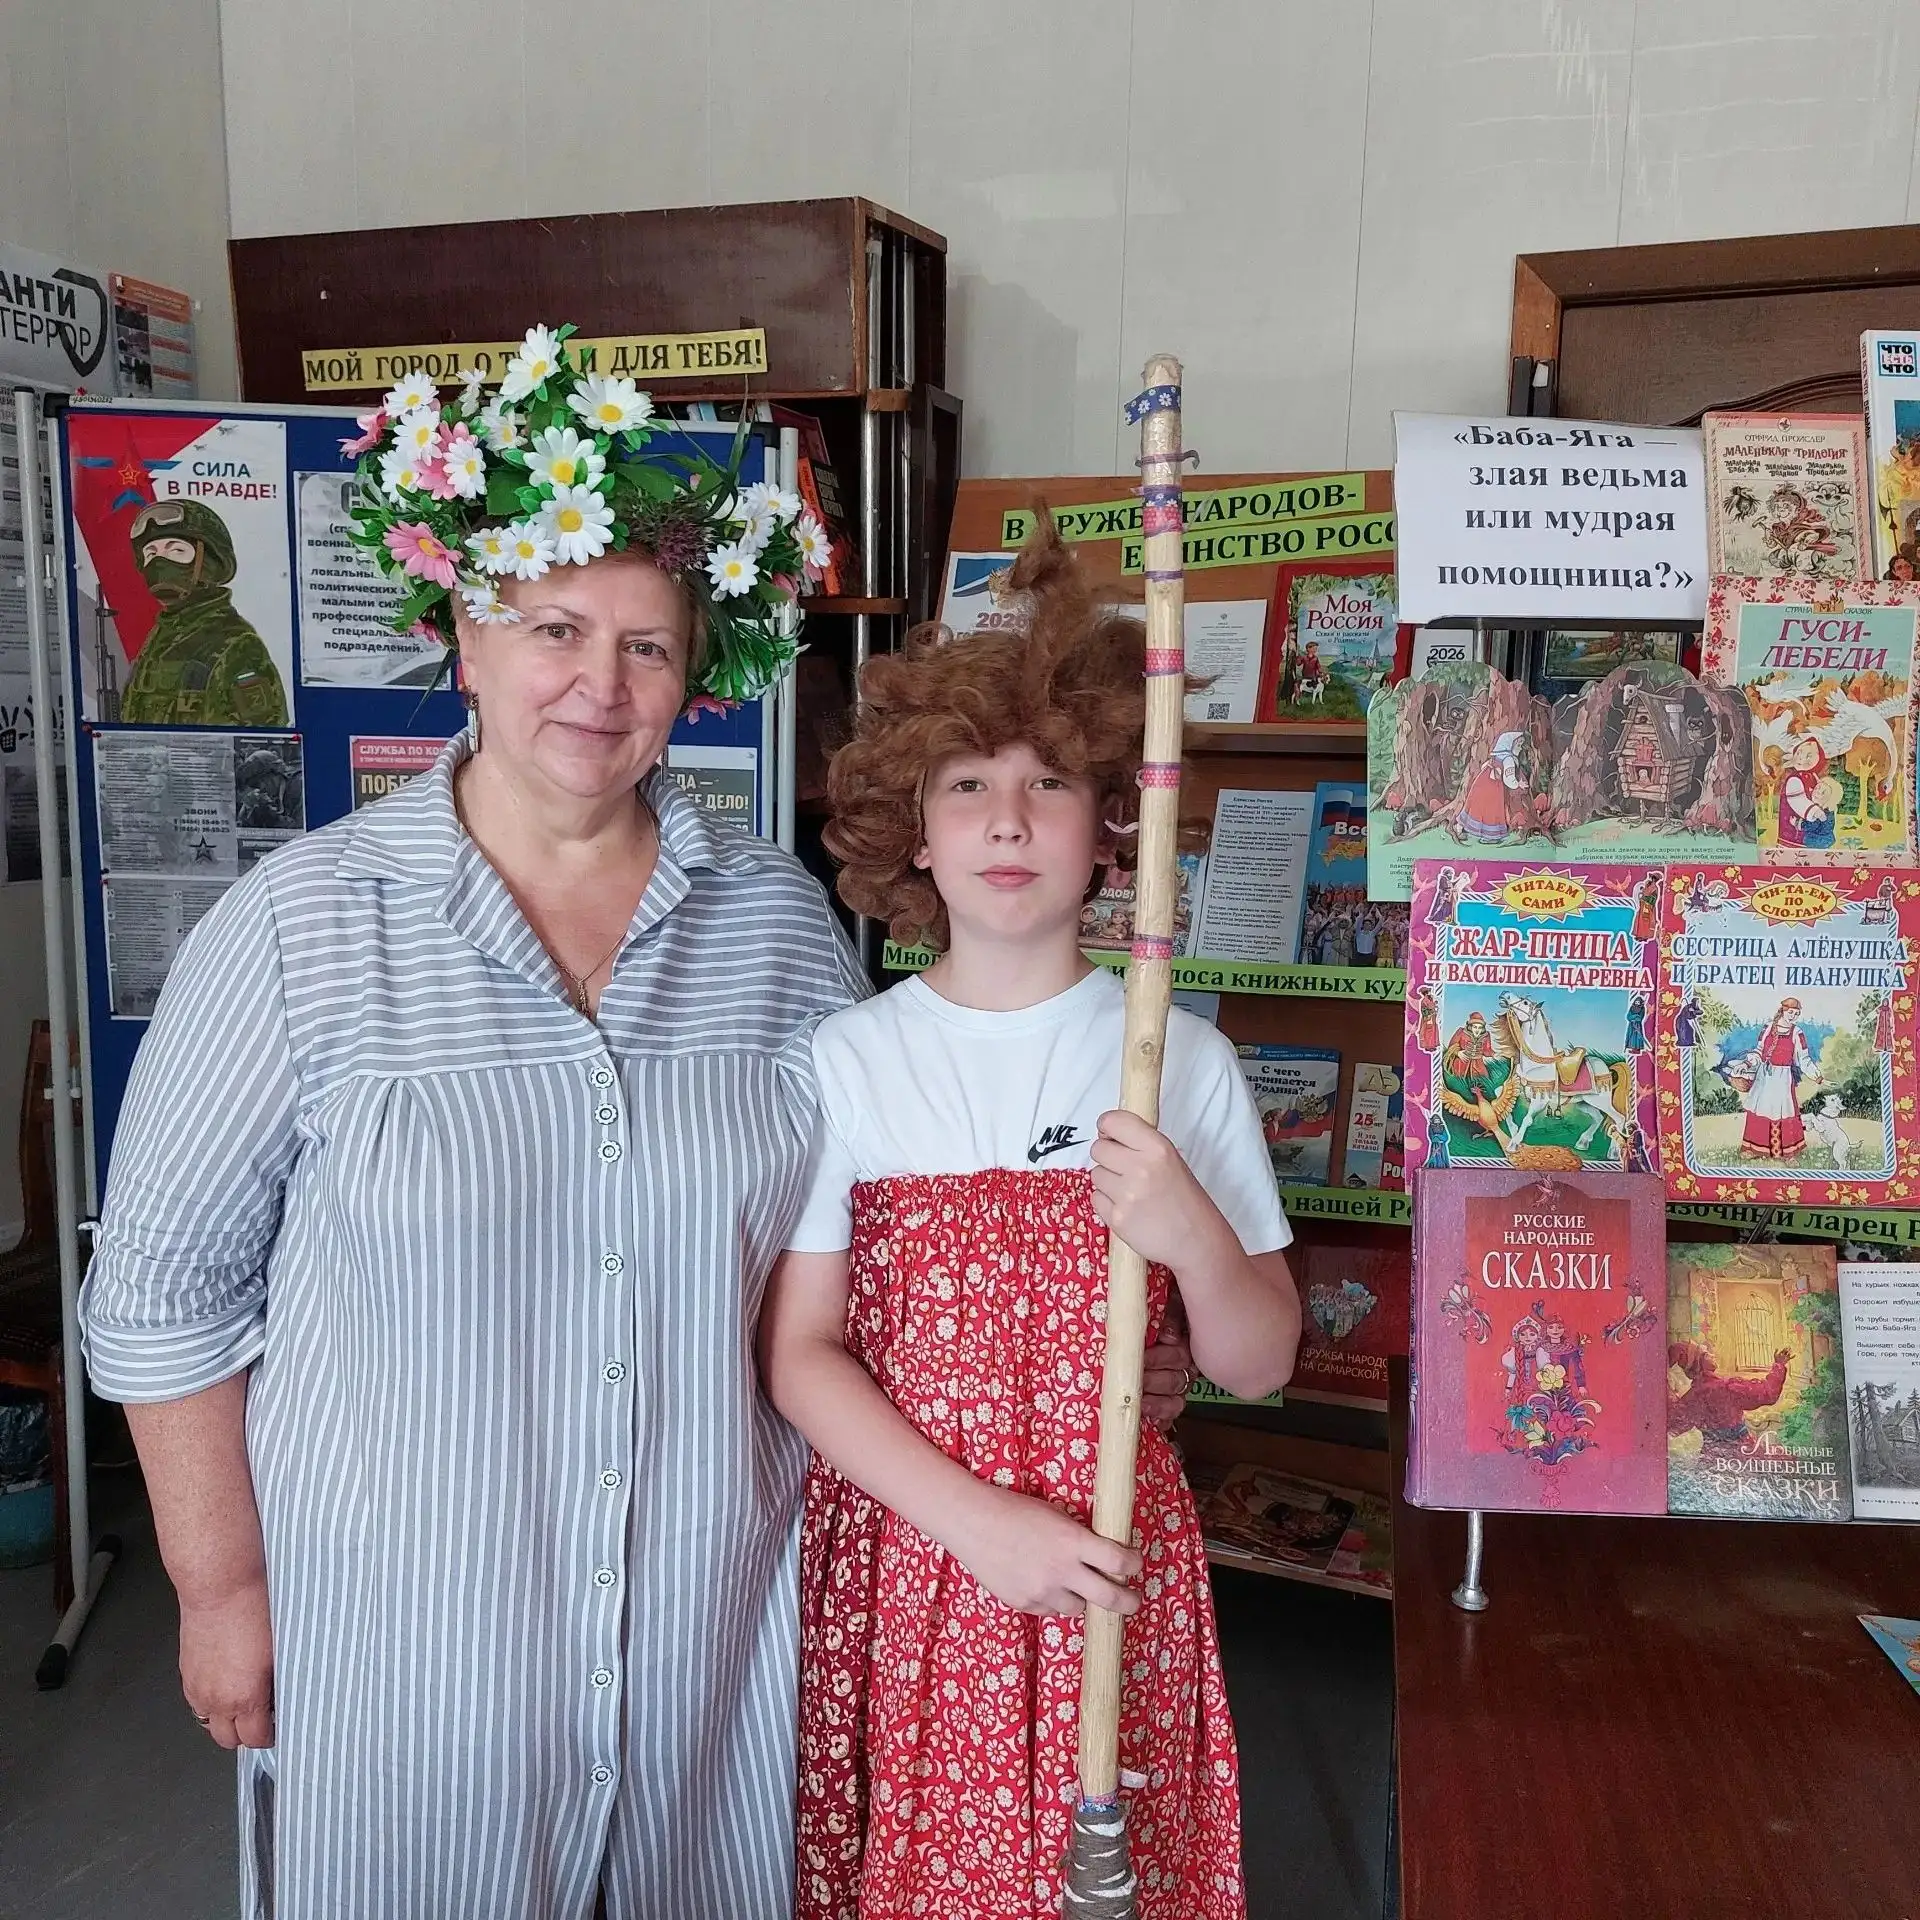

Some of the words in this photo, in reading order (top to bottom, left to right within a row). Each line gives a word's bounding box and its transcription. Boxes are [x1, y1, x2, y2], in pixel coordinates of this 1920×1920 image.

[1880, 344, 1913, 355] ЧТО
[304, 349, 364, 384] МОЙ
[375, 351, 461, 381] ГОРОД
[473, 351, 492, 371] О
[579, 347, 598, 373] И
[610, 344, 671, 377] ДЛЯ
[677, 338, 764, 370] ТЕБЯ!
[1882, 364, 1915, 374] ЧТО
[1453, 424, 1635, 448] «Баба-Яга
[1722, 445, 1790, 458] МАЛЕНЬКАЯ
[1793, 447, 1849, 460] ТРИЛОГИЯ
[191, 461, 251, 479] СИЛА
[1468, 464, 1548, 488] злая
[1560, 466, 1689, 491] ведьма
[168, 480, 181, 496] В
[187, 480, 278, 499] ПРАВДЕ!
[1004, 517, 1025, 542] В
[1464, 508, 1533, 530] или
[1544, 509, 1677, 538] мудрая
[333, 553, 353, 563] это
[1122, 528, 1304, 571] ЕНСТВО
[311, 566, 376, 579] локальны
[1437, 561, 1695, 591] помощница?»
[309, 582, 398, 596] политических
[321, 596, 375, 608] малыми
[1324, 593, 1375, 614] Моя
[1784, 605, 1813, 615] СТРАНА
[1843, 606, 1874, 616] СКАЗОК
[1304, 609, 1385, 630] Россия
[1778, 618, 1872, 644] ГУСИ-
[323, 640, 424, 654] подразделений.
[1428, 647, 1466, 661] 2026
[1759, 645, 1889, 673] ЛЕБЕДИ
[359, 745, 407, 755] СЛУЖБА
[408, 746, 424, 756] ПО
[705, 793, 749, 811] ДЕЛО!
[1510, 878, 1581, 900] ЧИТАЕМ
[1756, 884, 1831, 903] ЧИ-ТА-ЕМ
[1521, 896, 1566, 910] САМИ
[1784, 896, 1804, 906] ПО
[1760, 904, 1826, 918] СЛО-ГАМ
[1451, 927, 1632, 966] ЖАР-ПТИЦА
[1672, 936, 1778, 961] СЕСТРИЦА
[1787, 935, 1909, 962] АЛЁНУШКА
[1230, 972, 1357, 994] книжных
[1427, 962, 1441, 981] И
[1448, 963, 1654, 992] ВАСИЛИСА-ЦАРЕВНА
[1672, 964, 1686, 984] И
[1695, 964, 1776, 990] БРАТЕЦ
[1784, 965, 1907, 988] ИВАНУШКА
[1260, 1065, 1271, 1074] С
[1273, 1066, 1302, 1077] чего
[1253, 1083, 1306, 1096] Родина?
[1294, 1195, 1381, 1218] нашей
[1512, 1214, 1587, 1230] РУССКИЕ
[1803, 1212, 1898, 1242] ларец
[1503, 1230, 1596, 1248] НАРОДНЫЕ
[1481, 1250, 1613, 1291] СКАЗКИ
[1867, 1315, 1889, 1323] трубы
[1302, 1347, 1345, 1362] ДРУЖБА
[1856, 1341, 1894, 1349] Вышивает
[1300, 1359, 1315, 1371] НА
[1317, 1361, 1380, 1381] САМАРСКОЙ
[1715, 1457, 1837, 1476] ВОЛШЕБНЫЕ
[1715, 1477, 1841, 1511] СКАЗКИ
